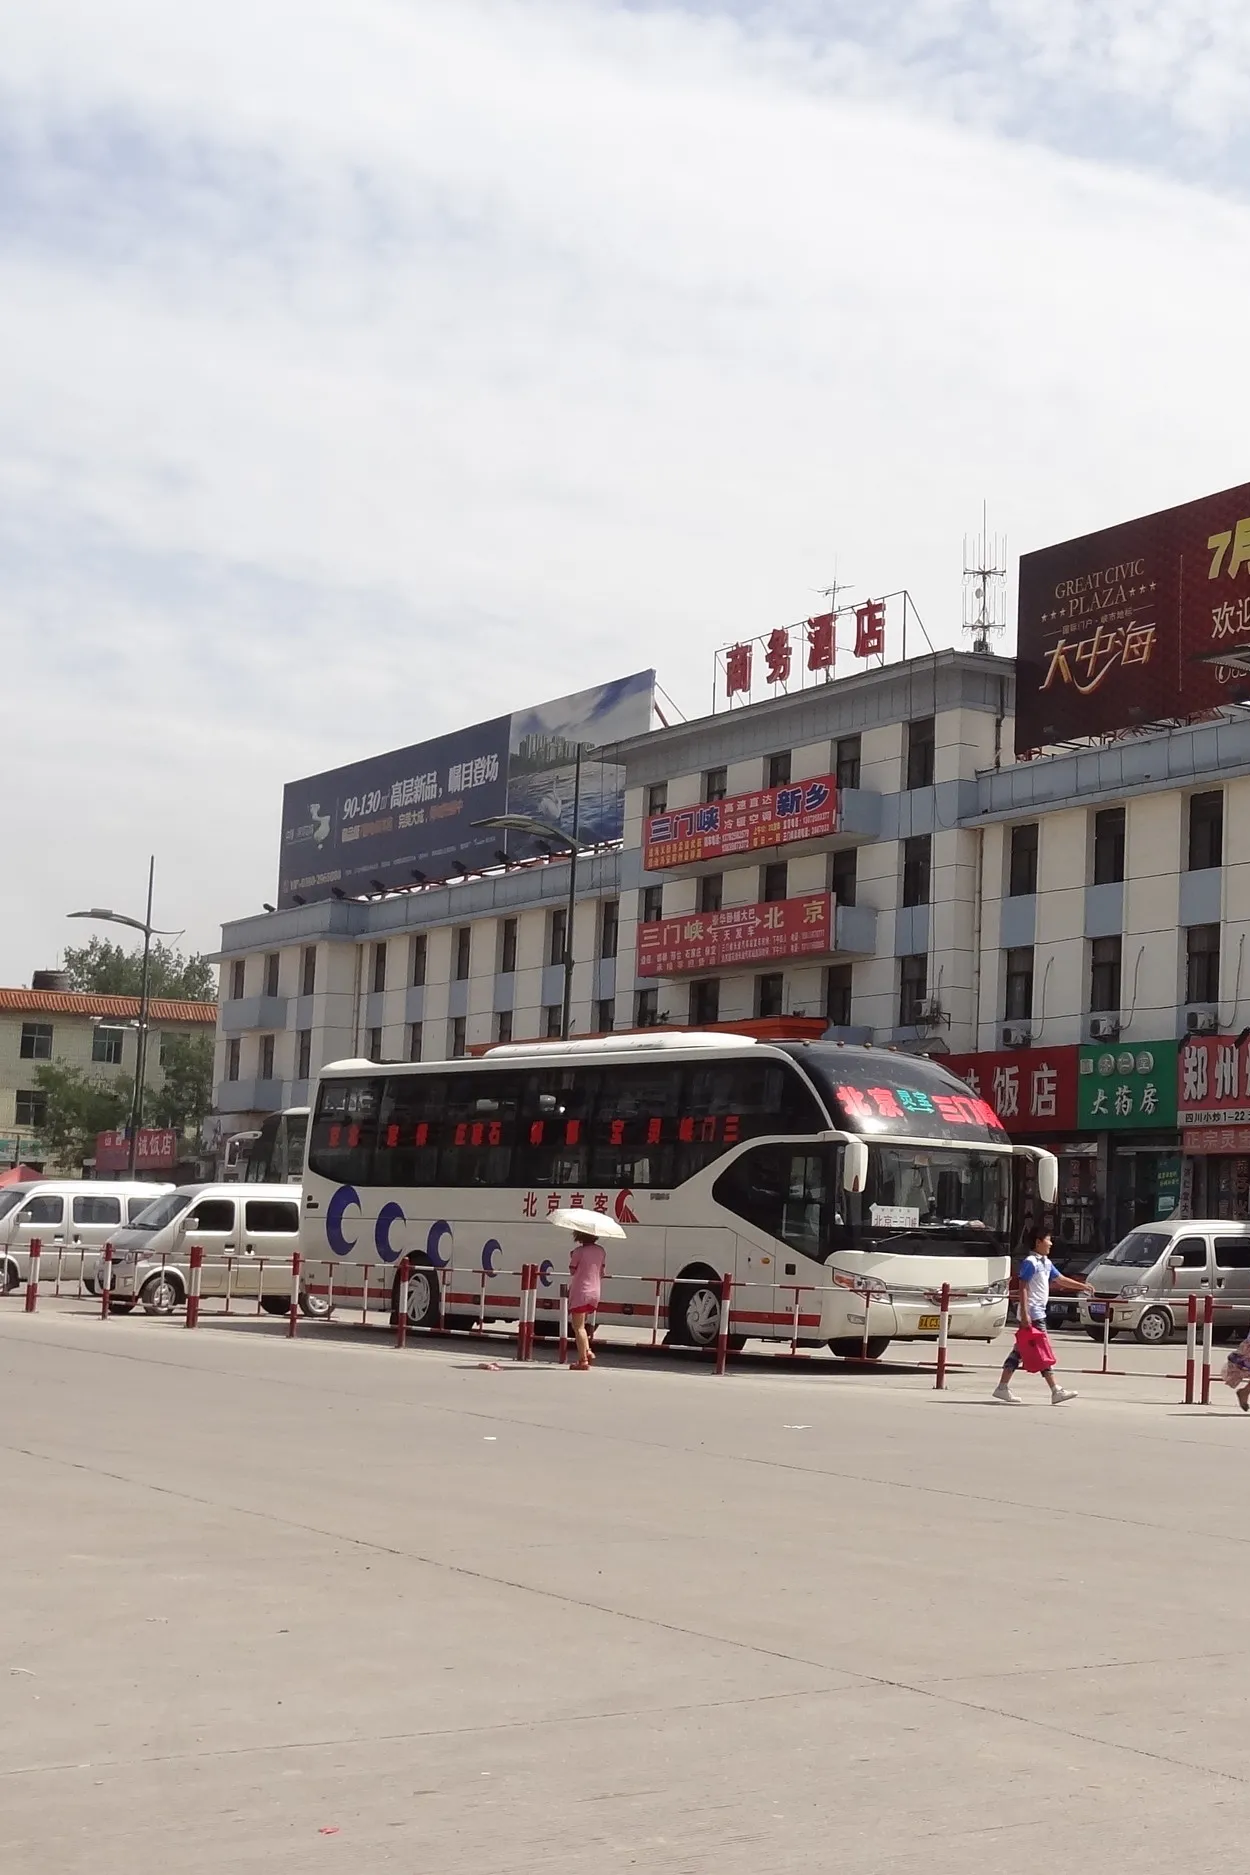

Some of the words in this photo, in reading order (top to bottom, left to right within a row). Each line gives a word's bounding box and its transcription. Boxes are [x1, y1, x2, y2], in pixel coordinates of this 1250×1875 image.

[1055, 572, 1102, 599] GREAT
[1105, 558, 1145, 584] CIVIC
[1068, 584, 1127, 618] PLAZA
[726, 599, 886, 698] 商务酒店
[1038, 620, 1157, 695] 大中海
[650, 806, 720, 845] 三门峡
[724, 794, 772, 814] 高速直达
[775, 782, 830, 819] 新乡
[723, 811, 772, 830] 冷暖空调
[641, 921, 704, 948] 三门峡
[763, 900, 825, 930] 北京
[711, 926, 755, 943] 天天发车
[836, 1086, 904, 1118] 北京
[1090, 1083, 1160, 1116] 大药房
